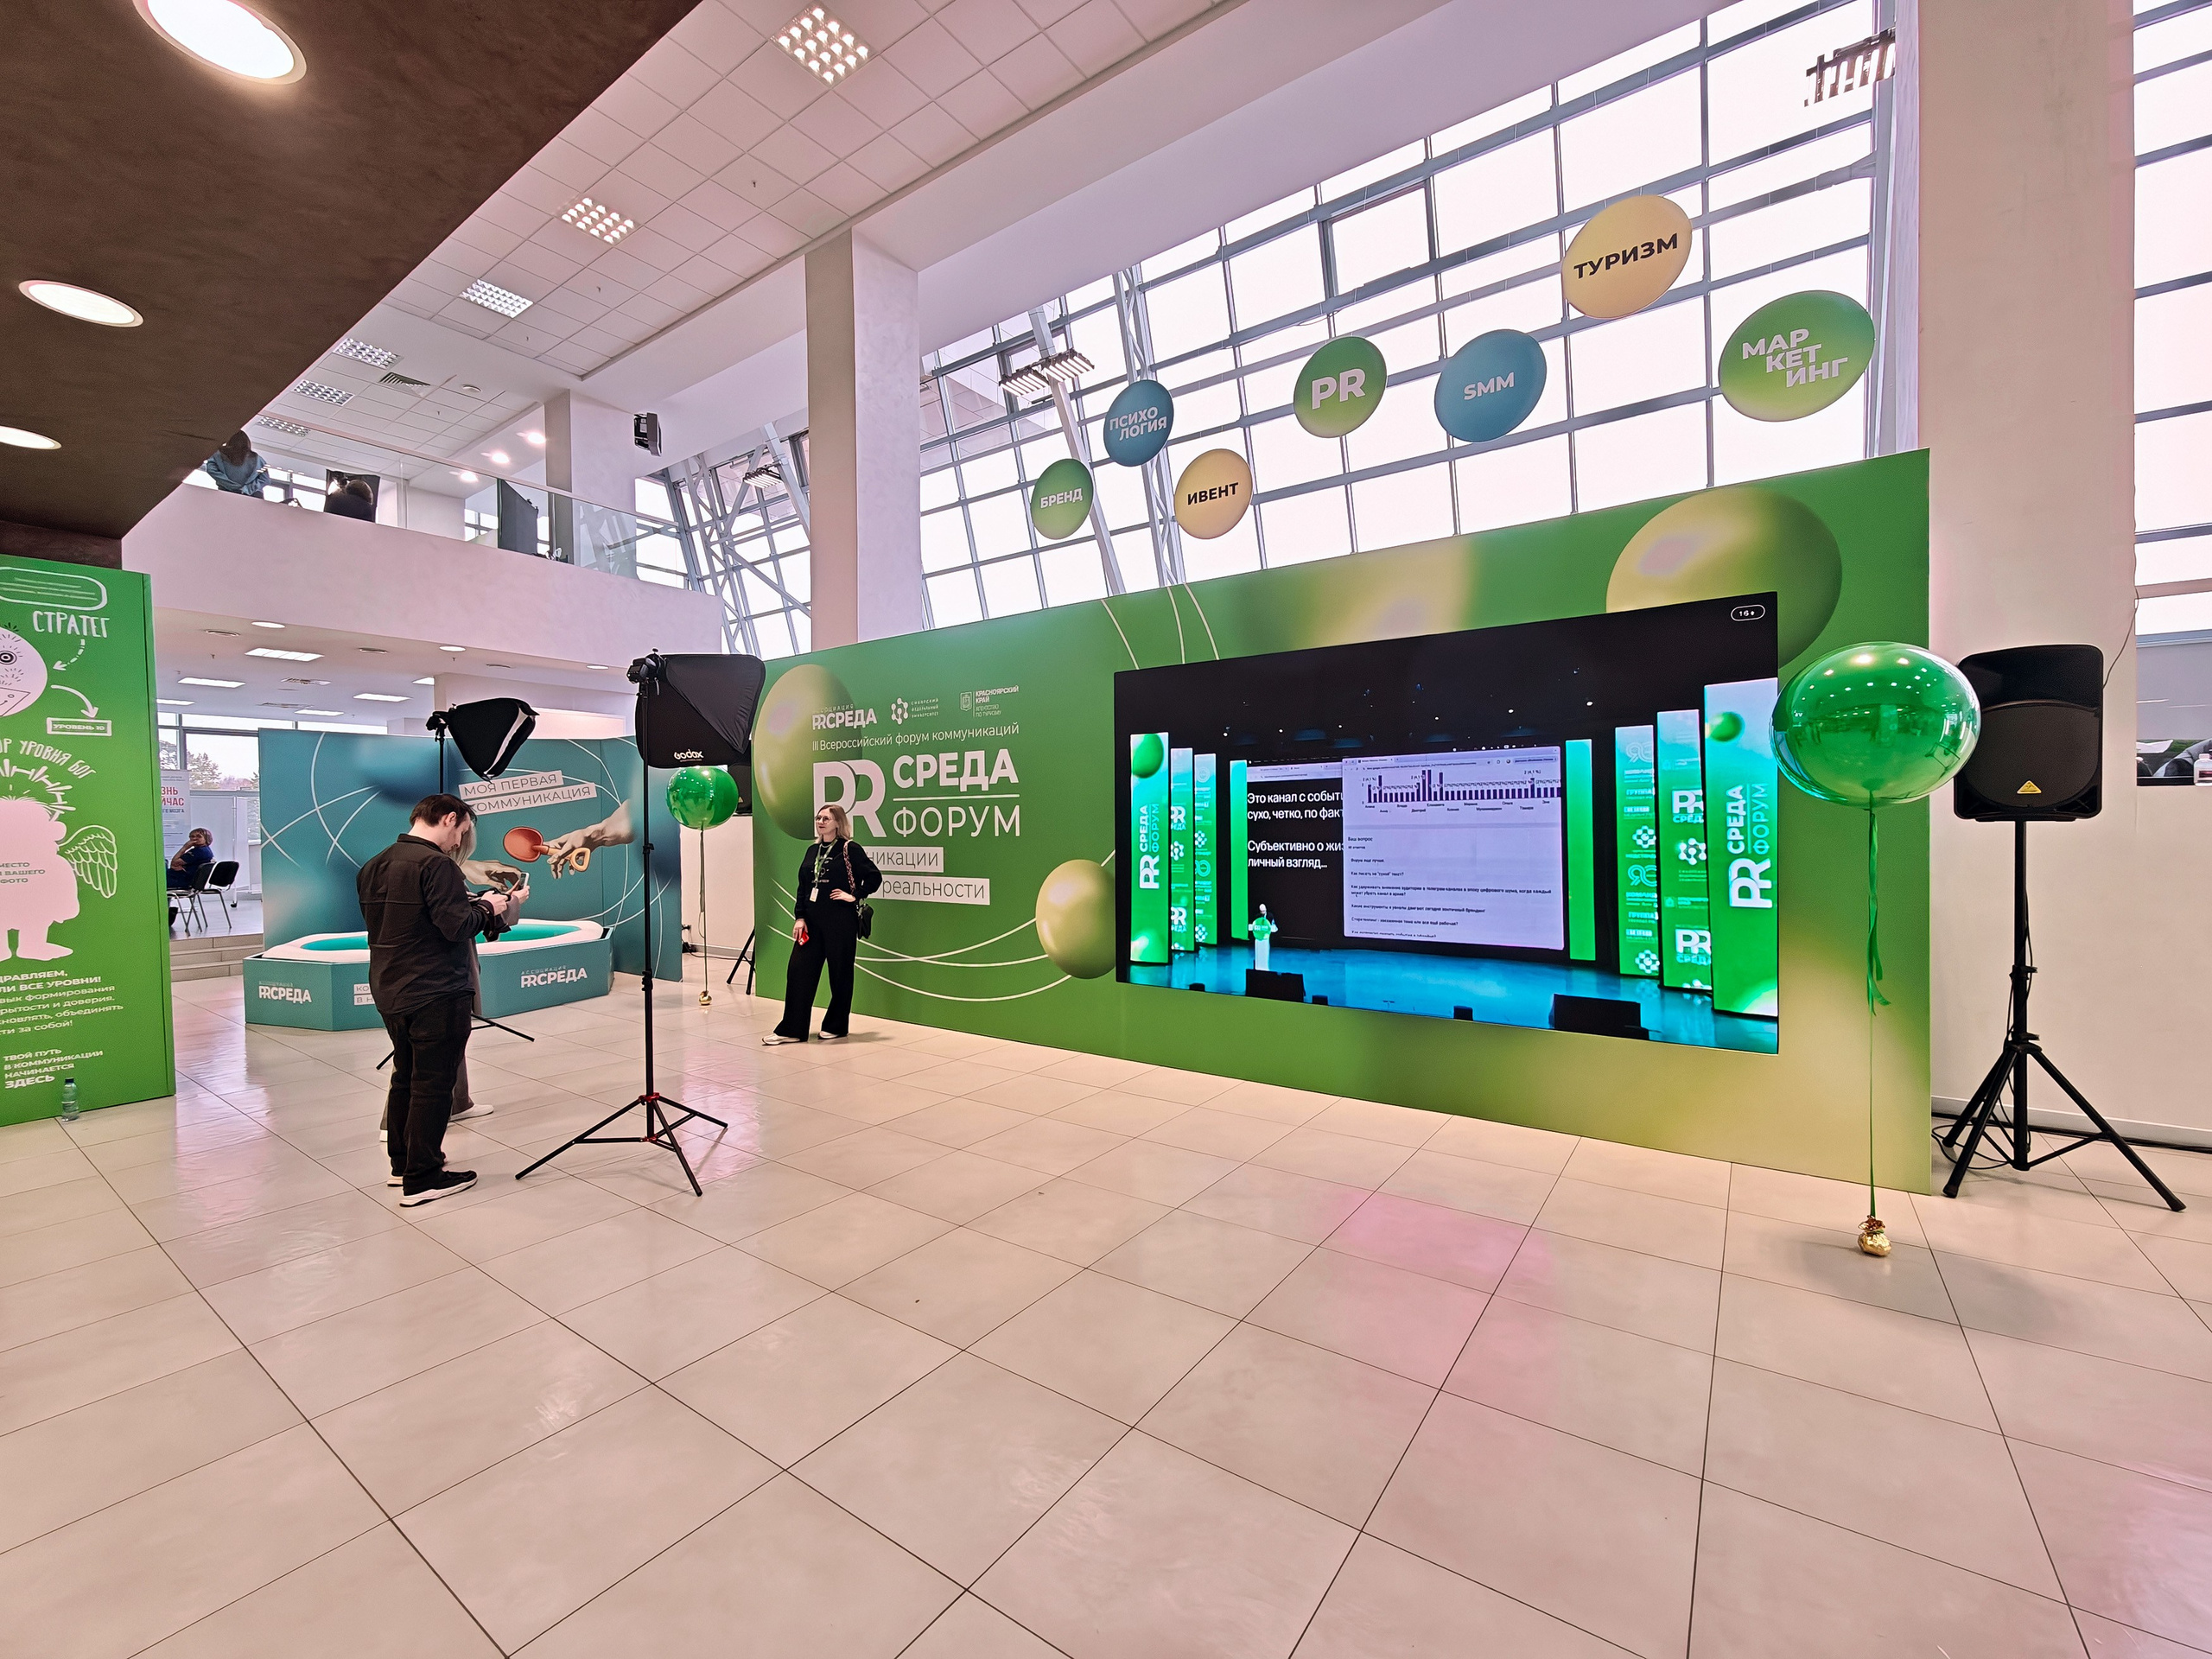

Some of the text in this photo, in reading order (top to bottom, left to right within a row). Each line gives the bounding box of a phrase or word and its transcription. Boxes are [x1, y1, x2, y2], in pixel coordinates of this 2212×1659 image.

[1573, 232, 1678, 279] ТУРИЗМ
[1741, 328, 1809, 360] МАР
[1766, 343, 1822, 373] КЕТ
[1785, 357, 1849, 388] ИНГ
[1311, 367, 1367, 410] PR
[1463, 372, 1516, 400] SMM
[1109, 405, 1159, 431] ПСИХО
[1119, 415, 1168, 442] ЛОГИЯ
[1039, 487, 1083, 509] БРЕНД
[1187, 482, 1239, 505] ИВЕНТ
[33, 610, 110, 638] СТРАТЕГ
[976, 684, 1019, 696] КРАСНОЯРСКИЙ
[820, 734, 893, 751] Всероссийский
[895, 733, 930, 747] форум
[932, 721, 1020, 741] коммуникаций
[19, 740, 73, 766] УРОВНЯ
[67, 760, 97, 779] БОГ
[893, 748, 1020, 792] СРЕДА
[464, 773, 557, 797] МОЯ ПЕРВАЯ
[1247, 792, 1267, 804] Это
[1268, 793, 1297, 803] канал
[1299, 793, 1306, 803] с
[813, 759, 887, 838] PR
[893, 804, 1020, 838] ФОРУМ
[1139, 804, 1148, 853] СРЕДА
[1151, 803, 1160, 853] ФОРУМ
[1247, 810, 1271, 822] сухо,
[1272, 810, 1303, 820] четко,
[1304, 810, 1318, 819] по
[1726, 785, 1746, 855] СРЕДА
[1751, 783, 1770, 855] ФОРУМ
[1247, 840, 1315, 854] Субъективно
[1316, 842, 1324, 851] о
[1140, 855, 1160, 889] PR
[1247, 856, 1328, 869] личный взгляд...
[882, 880, 984, 899] реальности
[1729, 857, 1773, 909] PR
[19, 982, 44, 991] ВСЕ
[47, 976, 102, 988] УРОВНИ!
[24, 986, 115, 1001] формирования
[55, 1005, 124, 1018] объединять
[63, 995, 115, 1007] доверия.
[34, 1020, 73, 1031] собой!
[3, 1048, 62, 1061] ТВОЙ ПУТЬ
[13, 1050, 104, 1069] КОММУНИКАЦИИ
[4, 1063, 75, 1079] НАЧИНАЕТСЯ
[4, 1074, 55, 1089] ЗДЕСЬ
